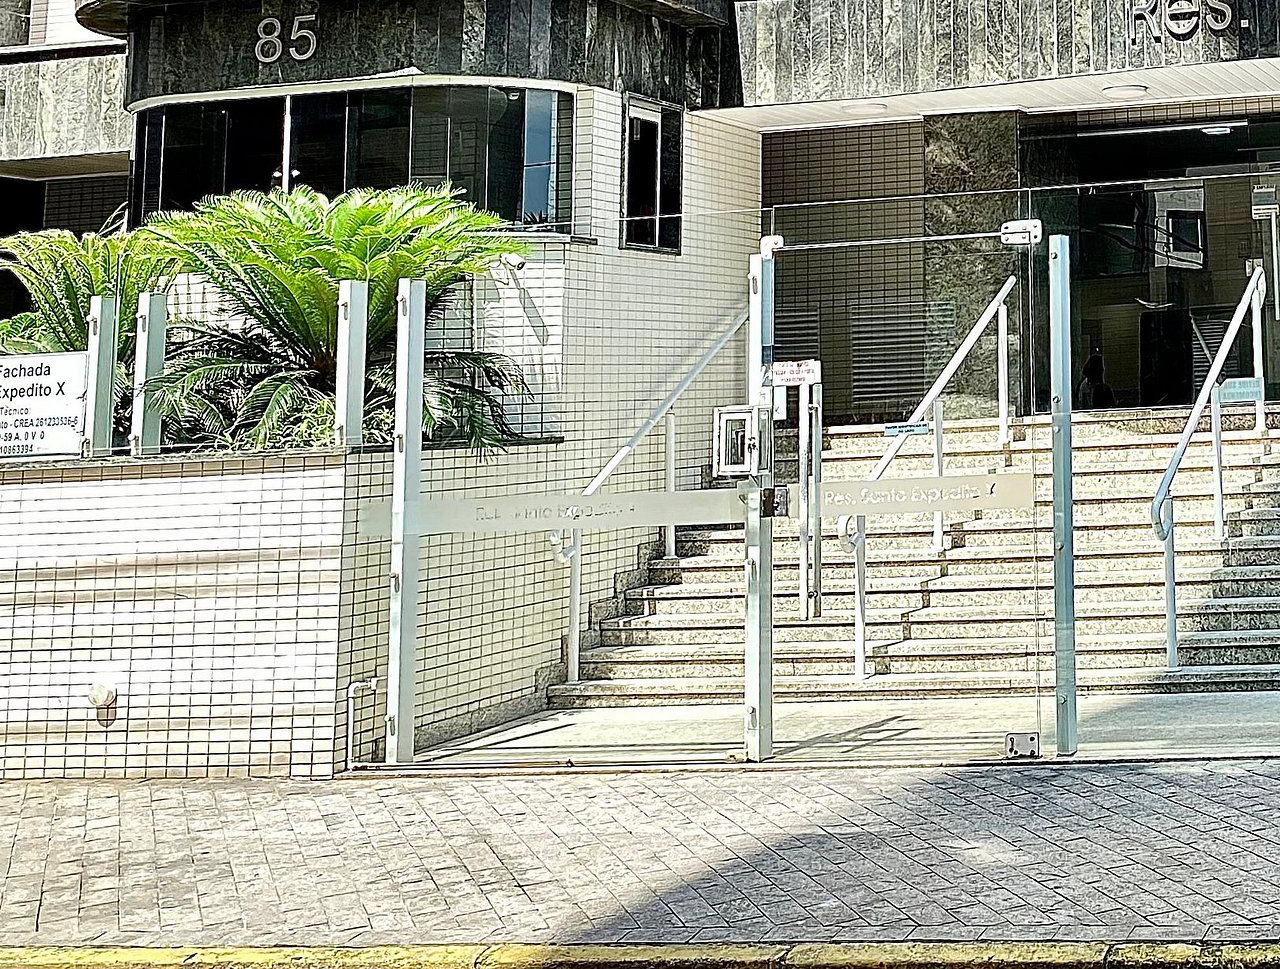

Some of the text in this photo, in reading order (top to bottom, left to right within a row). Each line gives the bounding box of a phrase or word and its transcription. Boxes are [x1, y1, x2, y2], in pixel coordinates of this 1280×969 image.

[254, 14, 317, 63] 85
[0, 382, 65, 401] xpedito X
[14, 418, 34, 428] CREA
